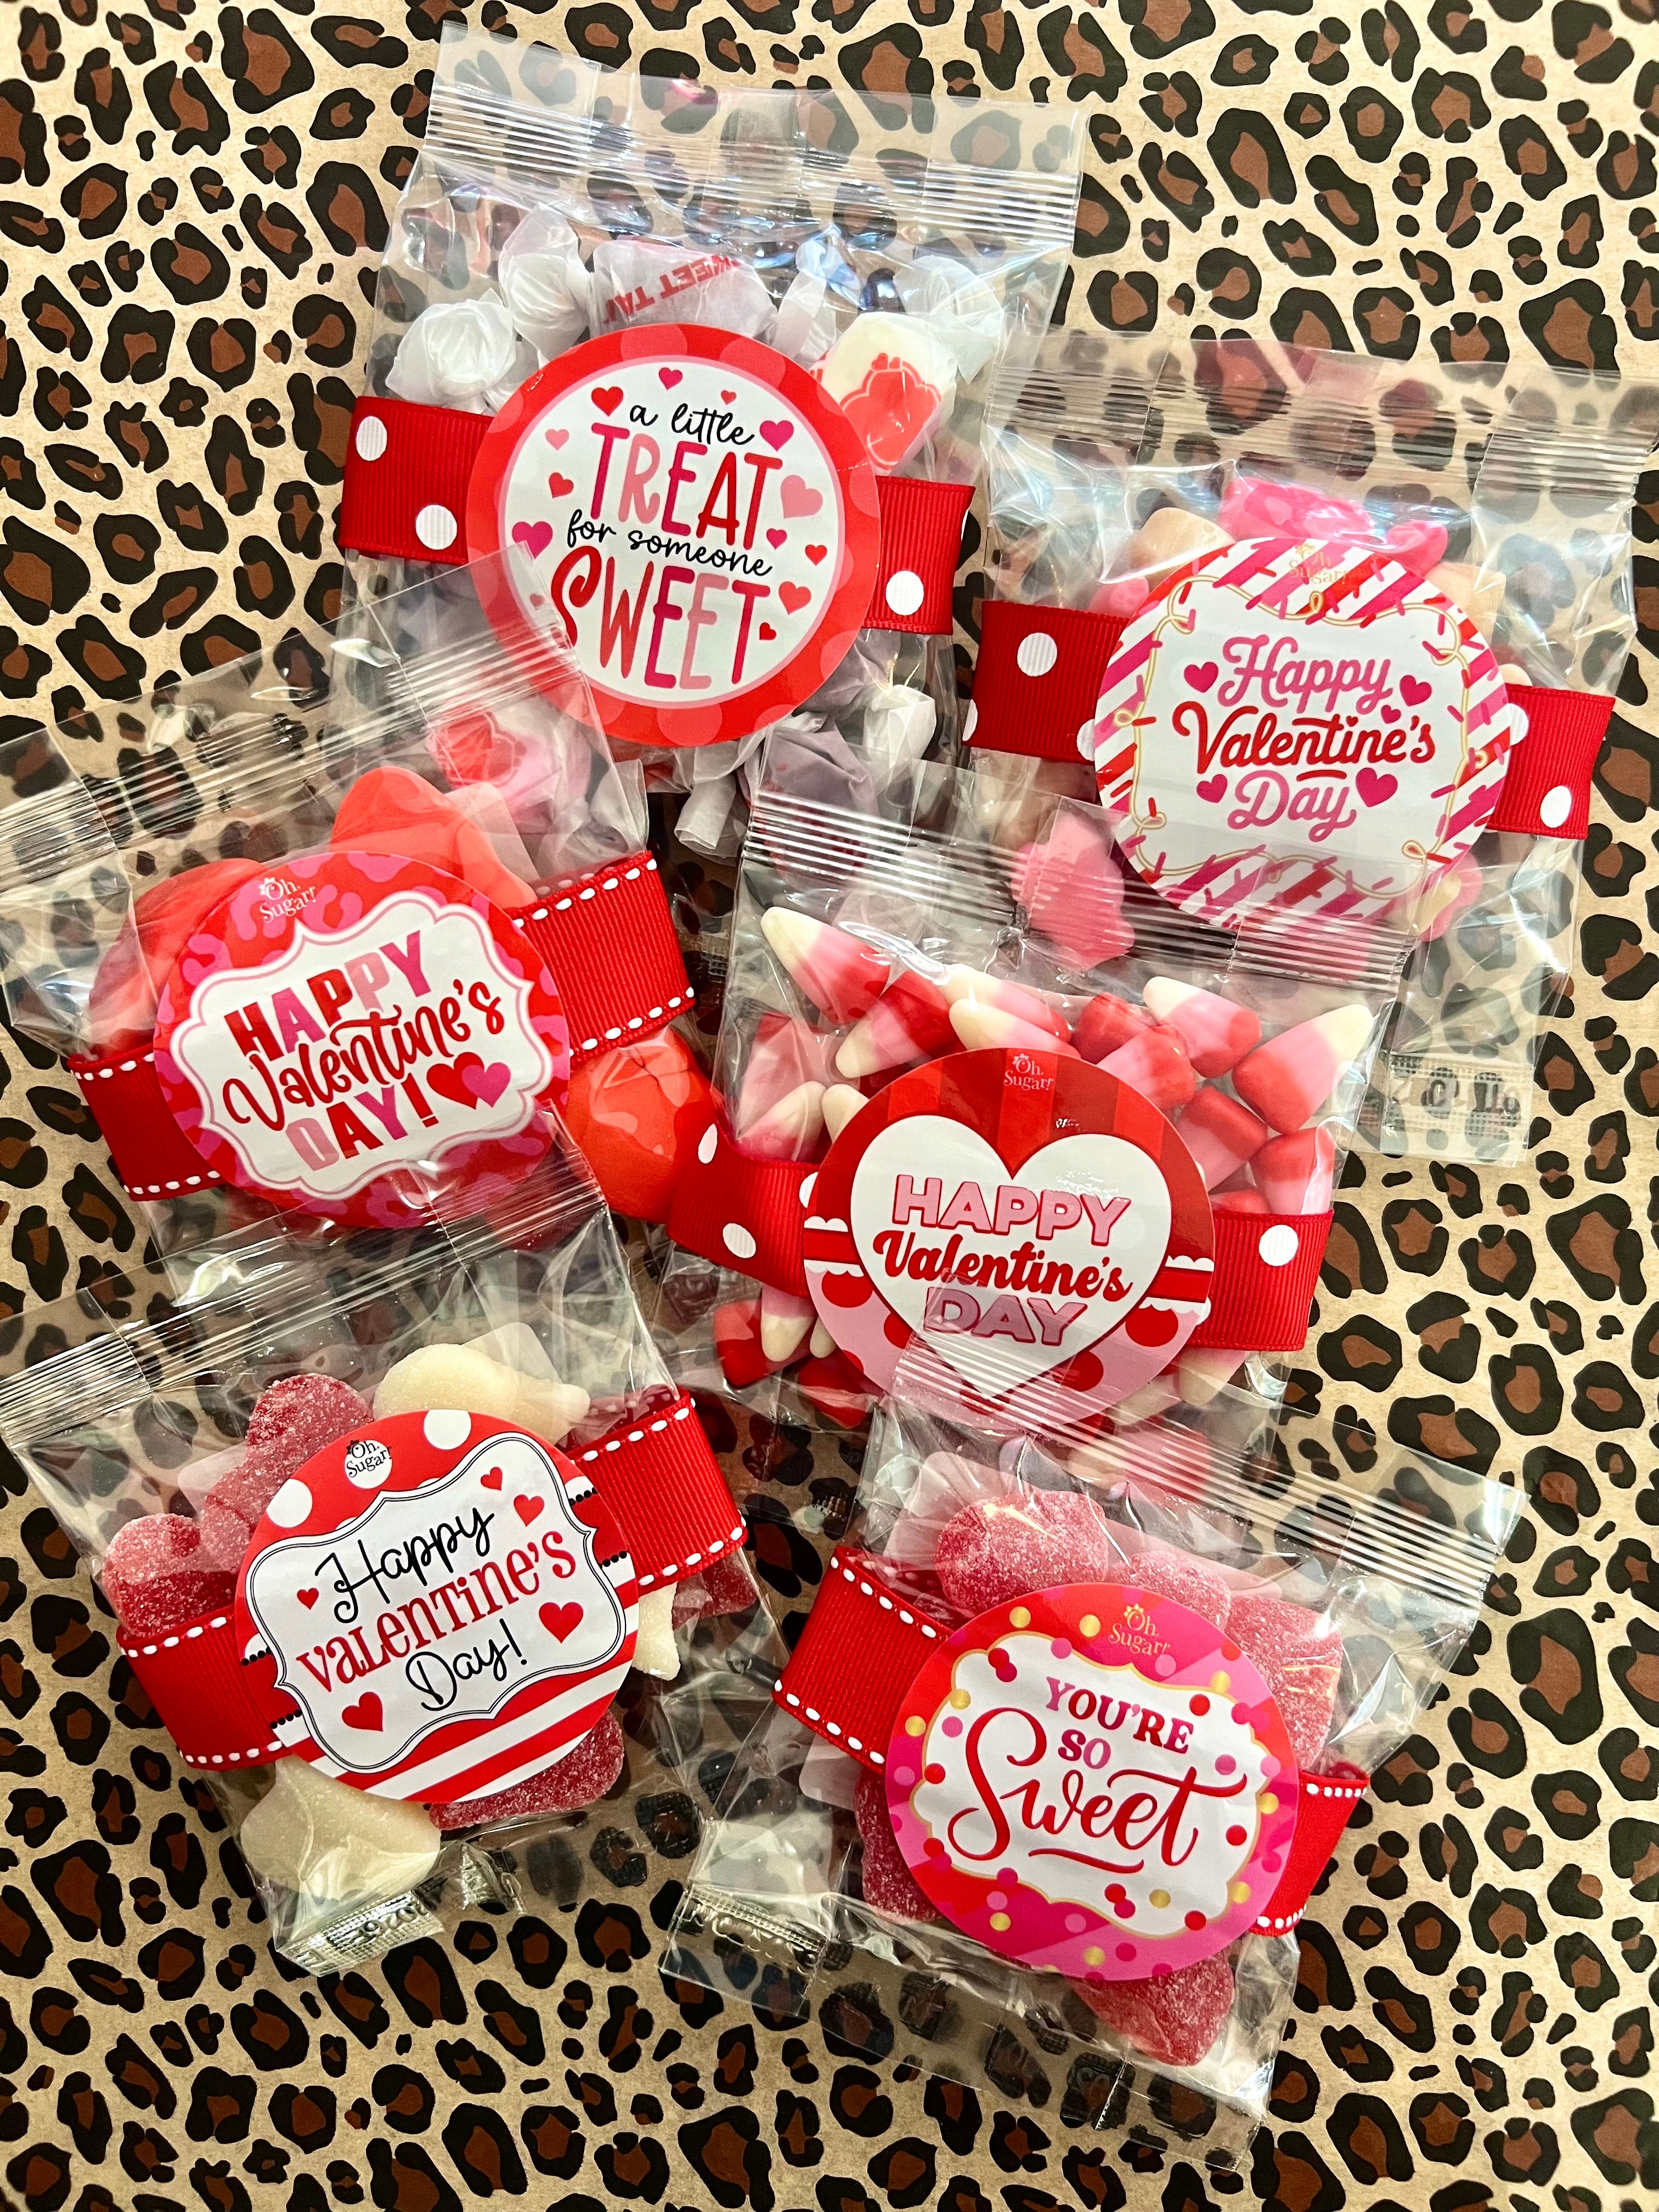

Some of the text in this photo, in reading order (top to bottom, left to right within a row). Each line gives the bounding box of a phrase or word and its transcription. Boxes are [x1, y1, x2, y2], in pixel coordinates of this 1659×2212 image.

[629, 403, 754, 445] a little
[591, 424, 783, 550] TREAT
[567, 509, 772, 577] for someone
[551, 545, 771, 690] SWEET
[1217, 634, 1393, 715] Happy
[1172, 701, 1435, 774] Valentine's
[1227, 769, 1357, 842] Day
[259, 885, 317, 924] Sugar!
[224, 930, 432, 1061] HAPPY
[223, 979, 504, 1131] Valentine's
[1003, 1070, 1054, 1091] Sugar!
[285, 1073, 439, 1171] DAY!
[891, 1175, 1131, 1246] HAPPY
[873, 1229, 1134, 1301] Valentine's
[924, 1286, 1088, 1346] DAY
[346, 1446, 393, 1478] Sugar!
[315, 1506, 494, 1624] Happy
[405, 1618, 527, 1712] Day!
[1046, 1677, 1194, 1754] YOU'RE
[1058, 1729, 1111, 1769] SO
[948, 1707, 1247, 1866] Sweet
